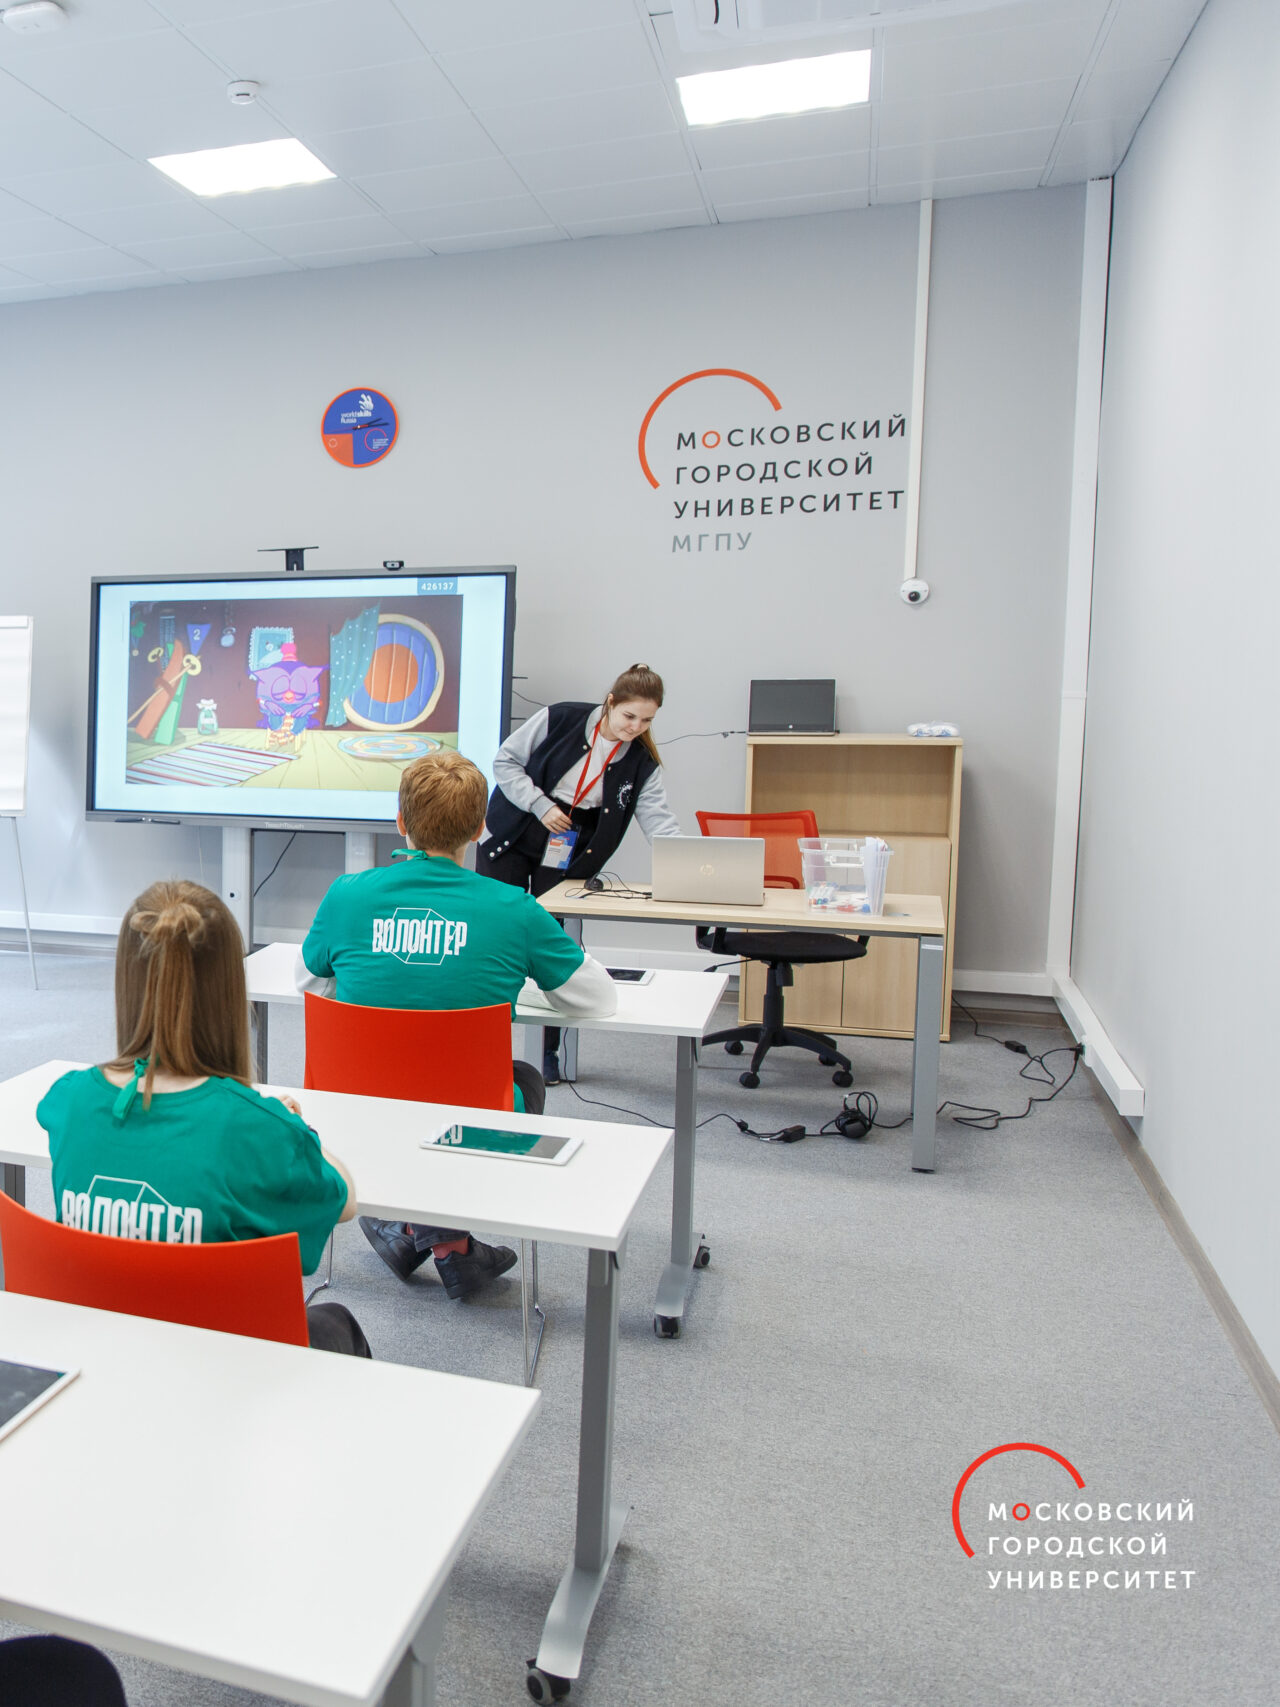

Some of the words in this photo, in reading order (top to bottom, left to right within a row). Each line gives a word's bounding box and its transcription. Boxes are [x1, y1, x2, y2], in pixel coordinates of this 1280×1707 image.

[676, 413, 906, 450] МОСКОВСКИЙ
[675, 451, 873, 485] ГОРОДСКОЙ
[673, 490, 904, 519] УНИВЕРСИТЕТ
[671, 532, 752, 553] МГПУ
[421, 581, 454, 591] 426137
[193, 628, 201, 641] 2
[372, 918, 468, 956] ВОЛОНТЕР
